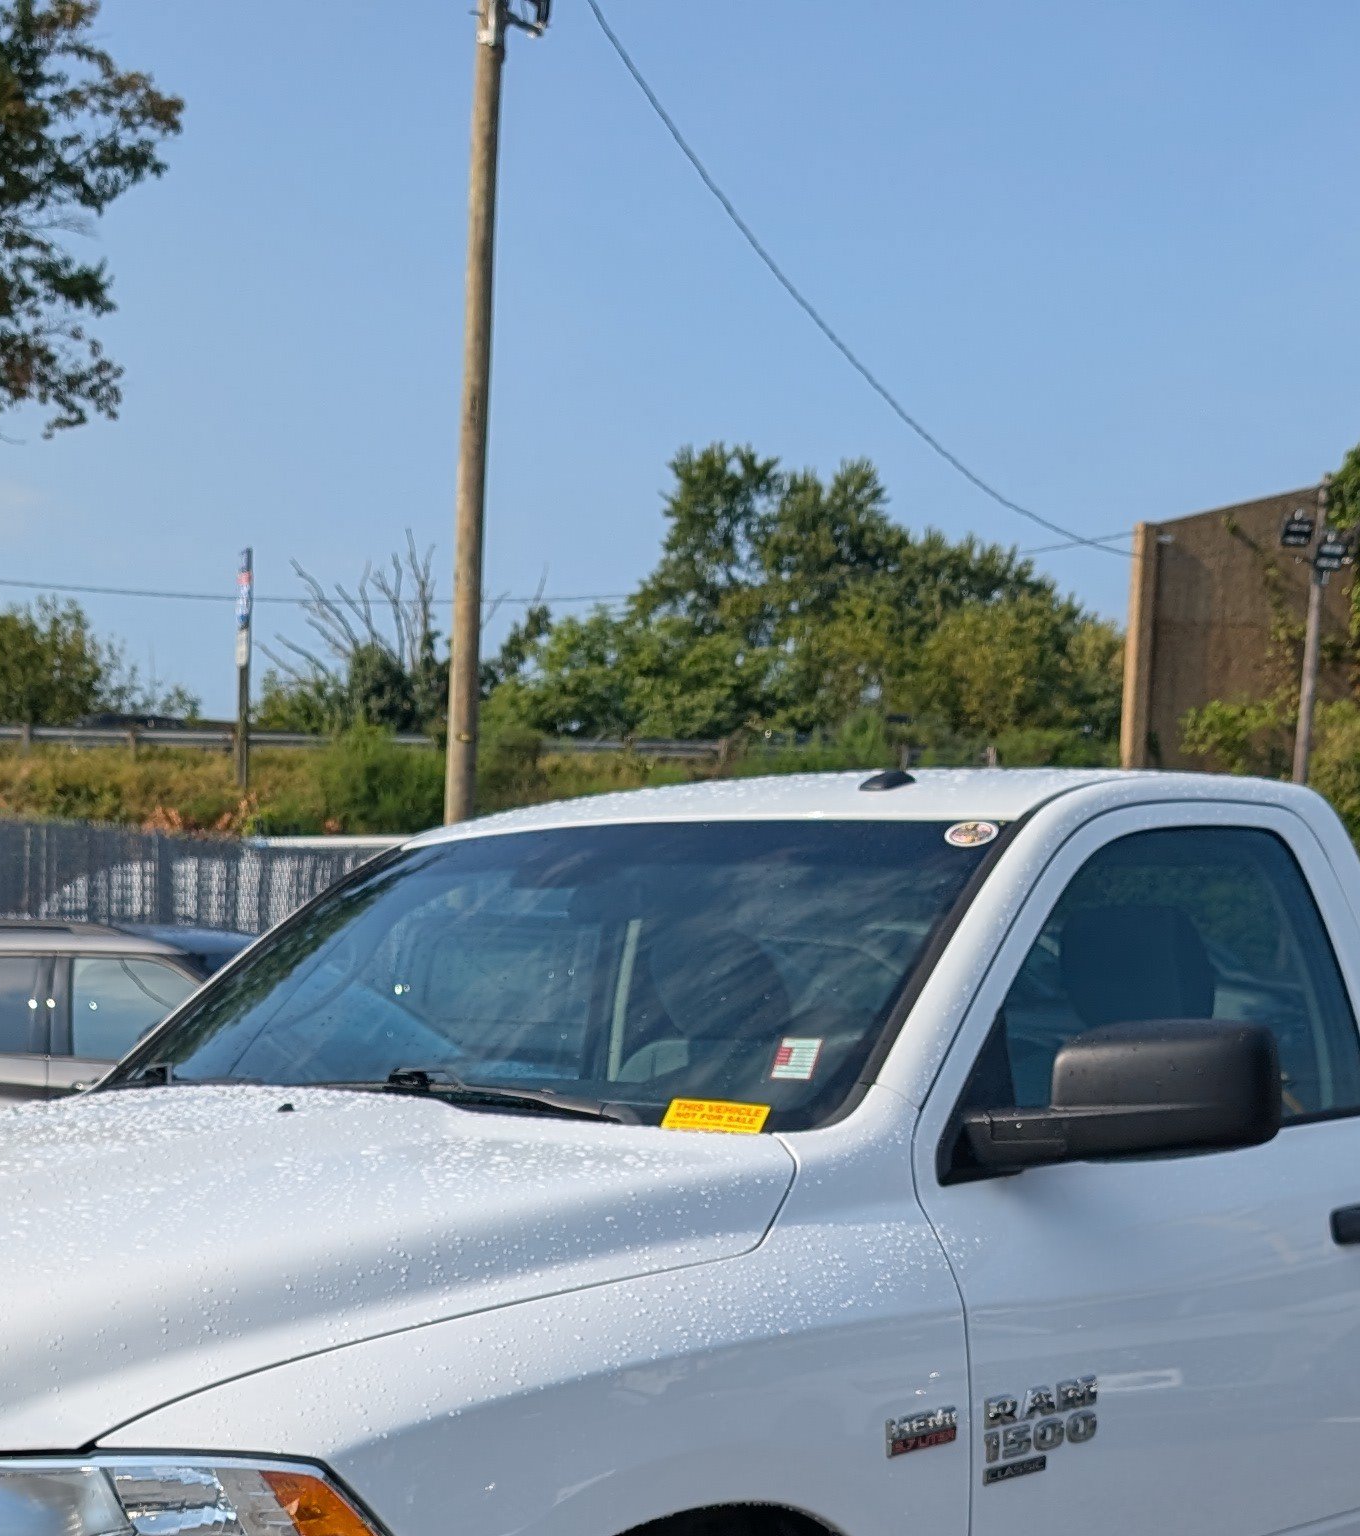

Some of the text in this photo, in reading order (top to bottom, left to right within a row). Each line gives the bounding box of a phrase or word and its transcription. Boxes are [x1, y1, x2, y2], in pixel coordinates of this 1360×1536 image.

[675, 1102, 764, 1117] THIS VEHICLE
[699, 1113, 724, 1121] FOR
[726, 1115, 757, 1125] SALE
[983, 1374, 1099, 1430] RAM
[983, 1409, 1098, 1464] 1500
